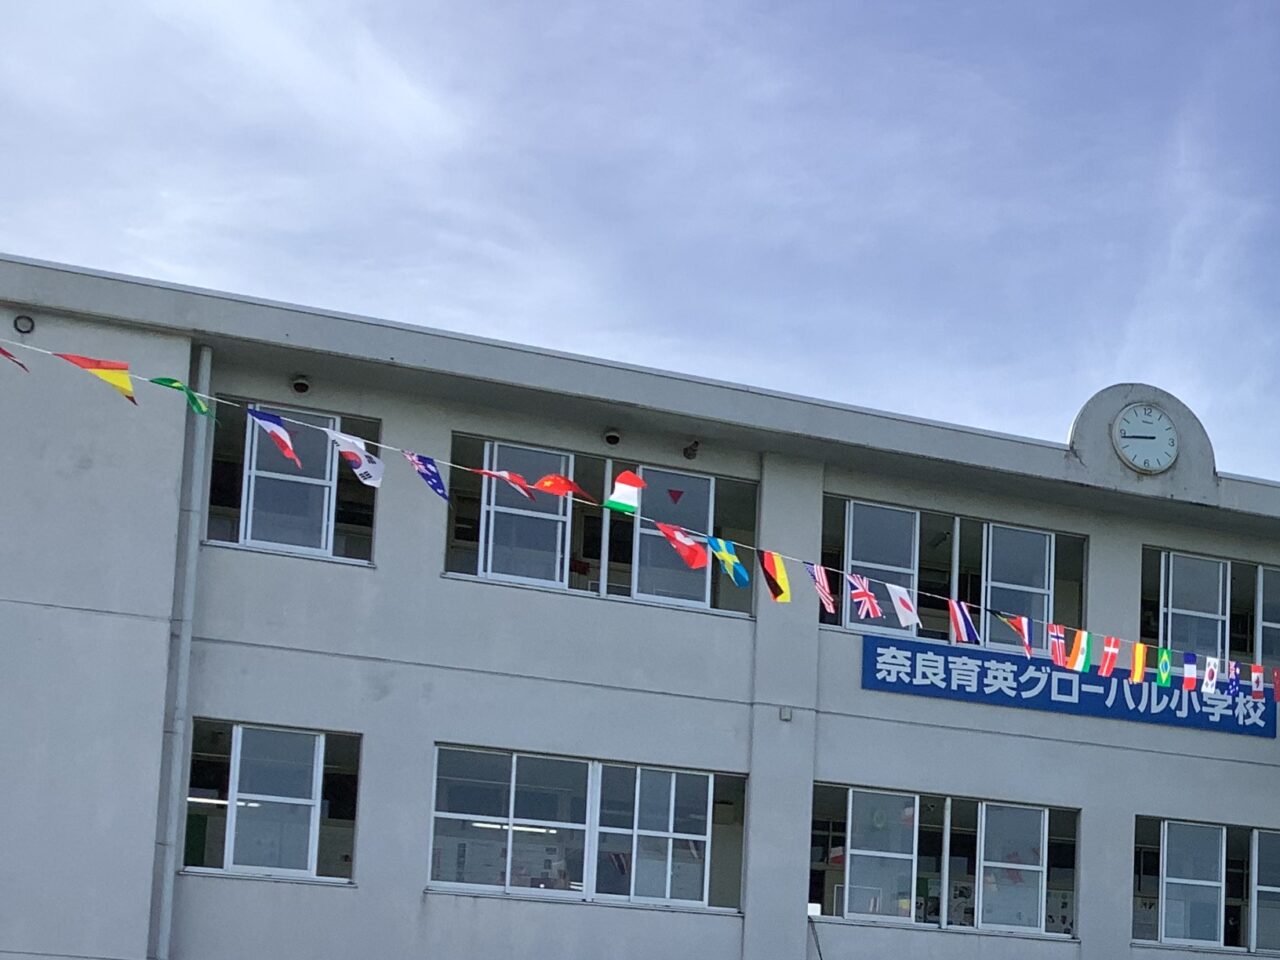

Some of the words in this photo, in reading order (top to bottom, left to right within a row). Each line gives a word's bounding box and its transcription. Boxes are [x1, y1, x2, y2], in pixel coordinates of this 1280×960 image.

[1143, 407, 1153, 417] 12
[1168, 438, 1175, 447] 3
[1143, 459, 1150, 467] 6
[876, 646, 1266, 728] 奈良育英グローバル小学校
